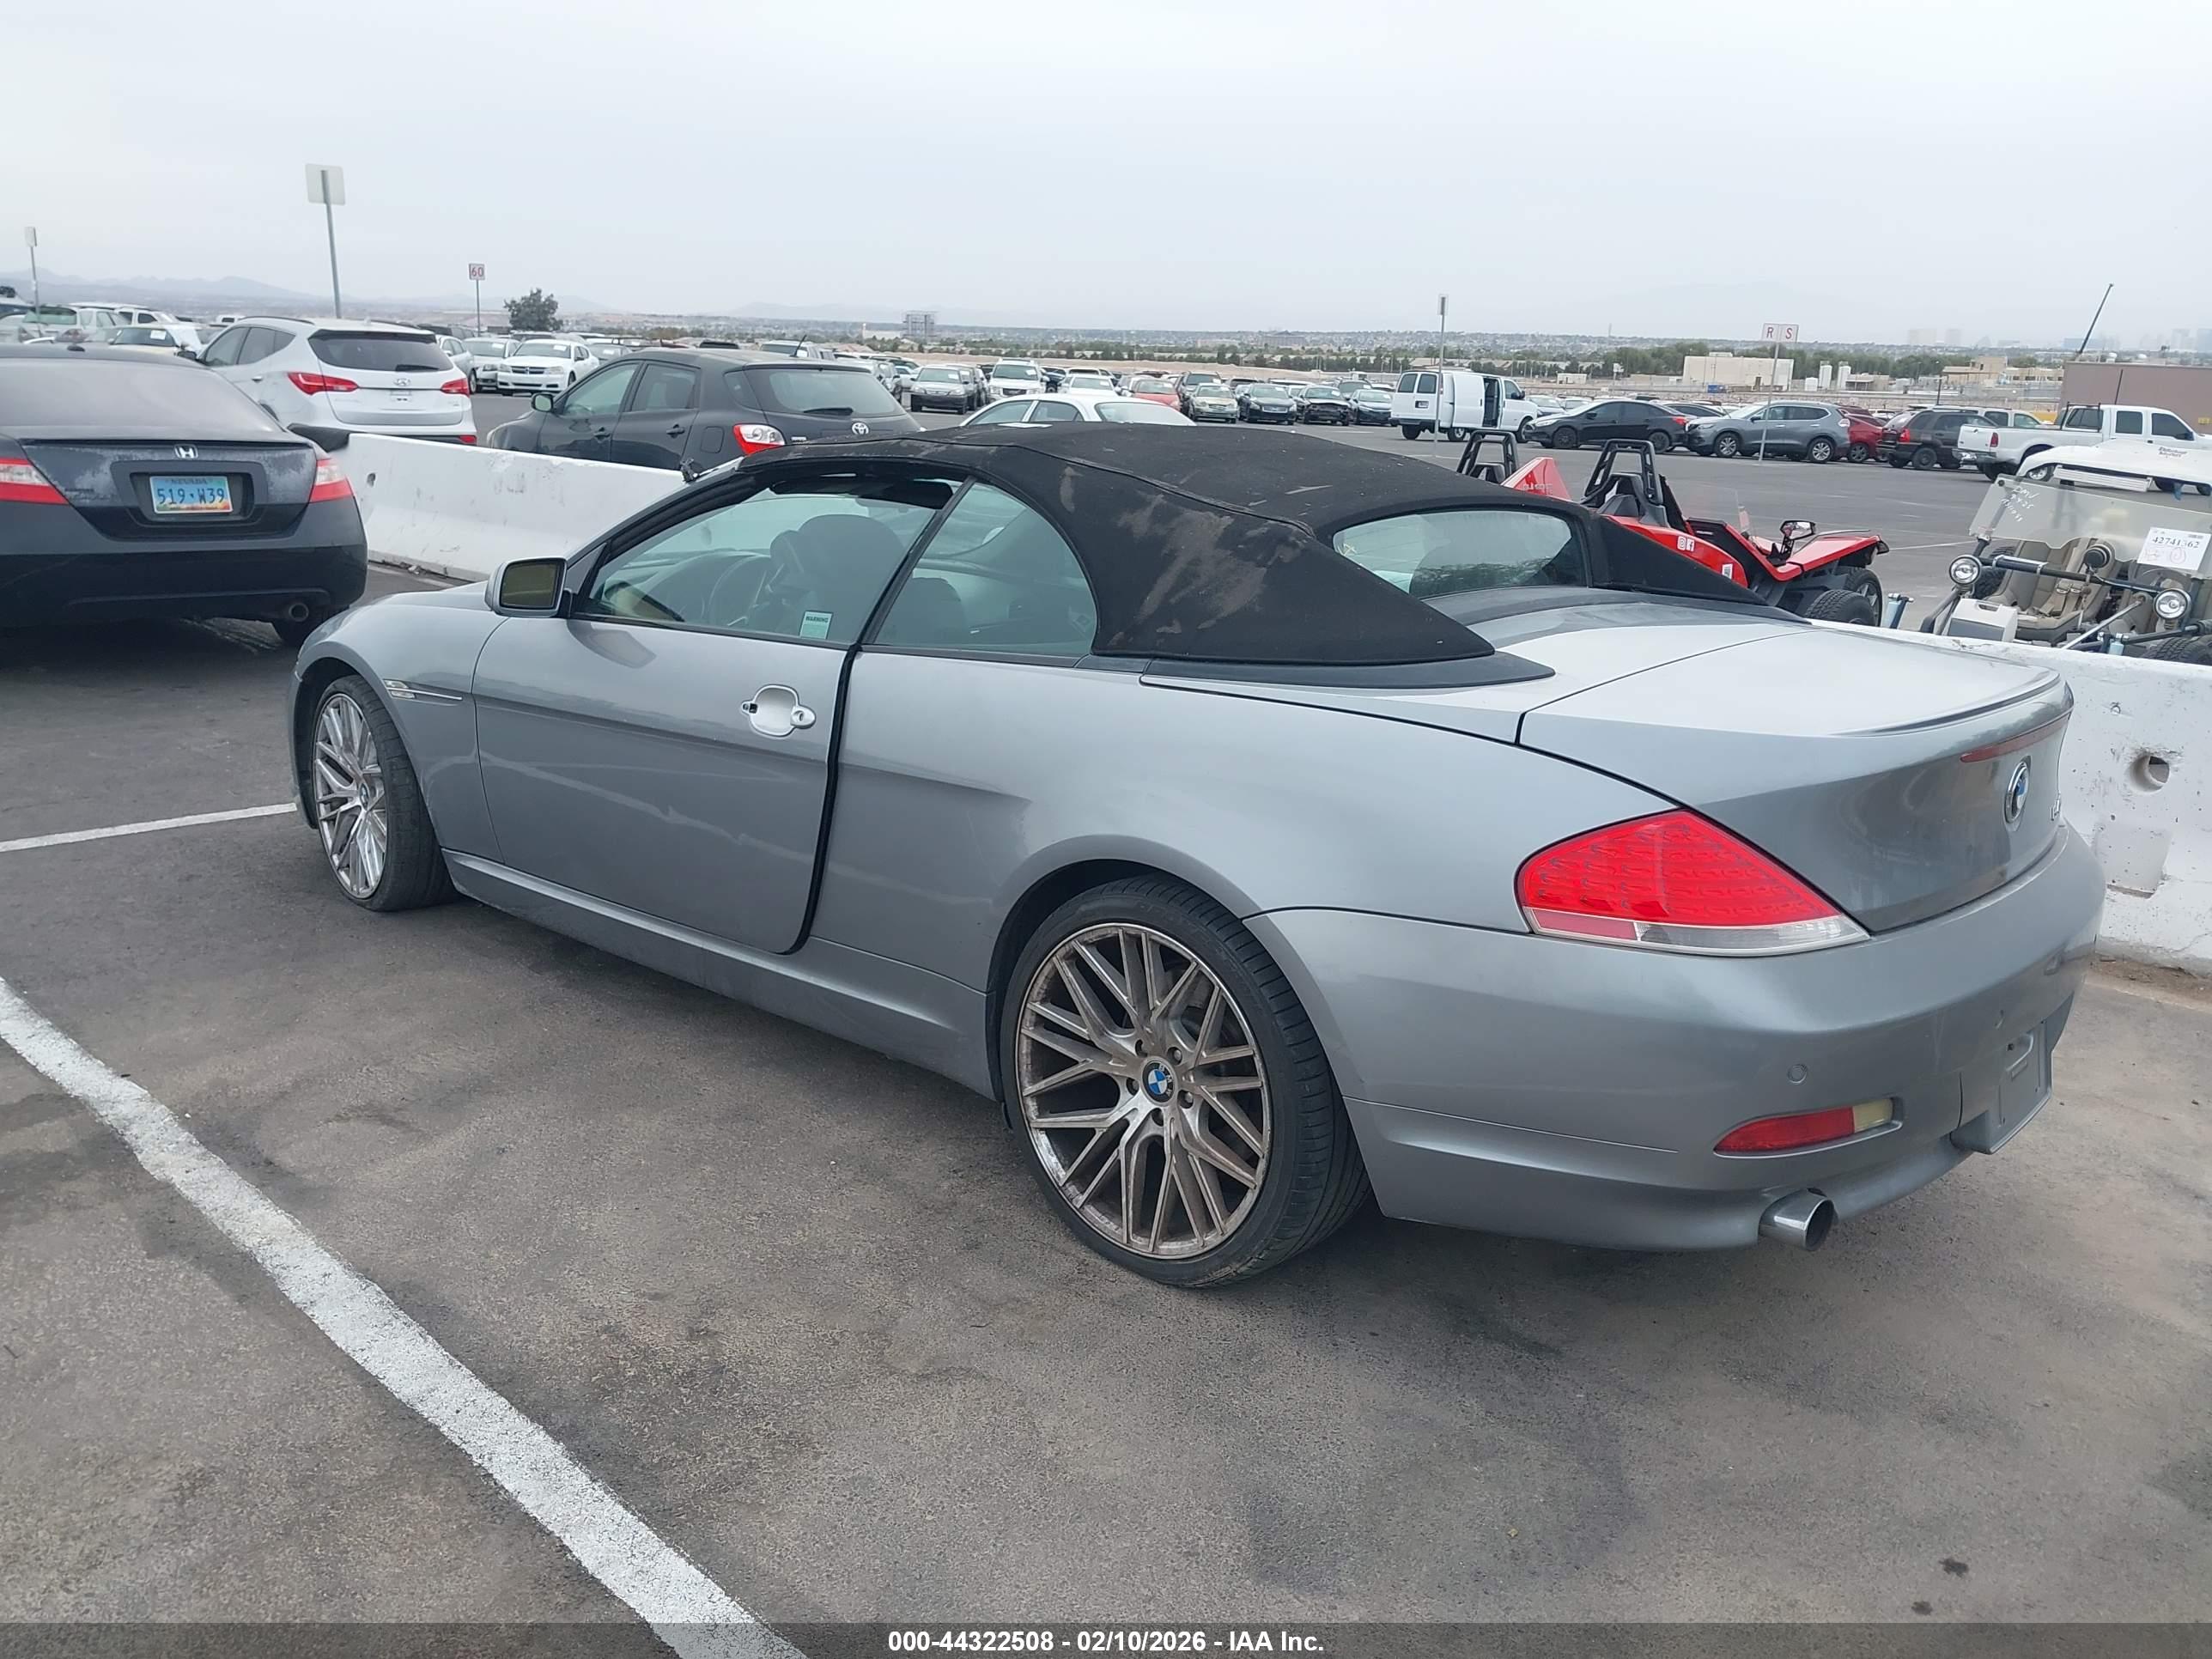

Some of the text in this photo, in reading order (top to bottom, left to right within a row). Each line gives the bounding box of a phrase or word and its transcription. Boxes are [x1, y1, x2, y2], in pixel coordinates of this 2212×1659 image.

[471, 266, 484, 276] 60
[1765, 326, 1774, 338] R
[1785, 327, 1793, 339] S
